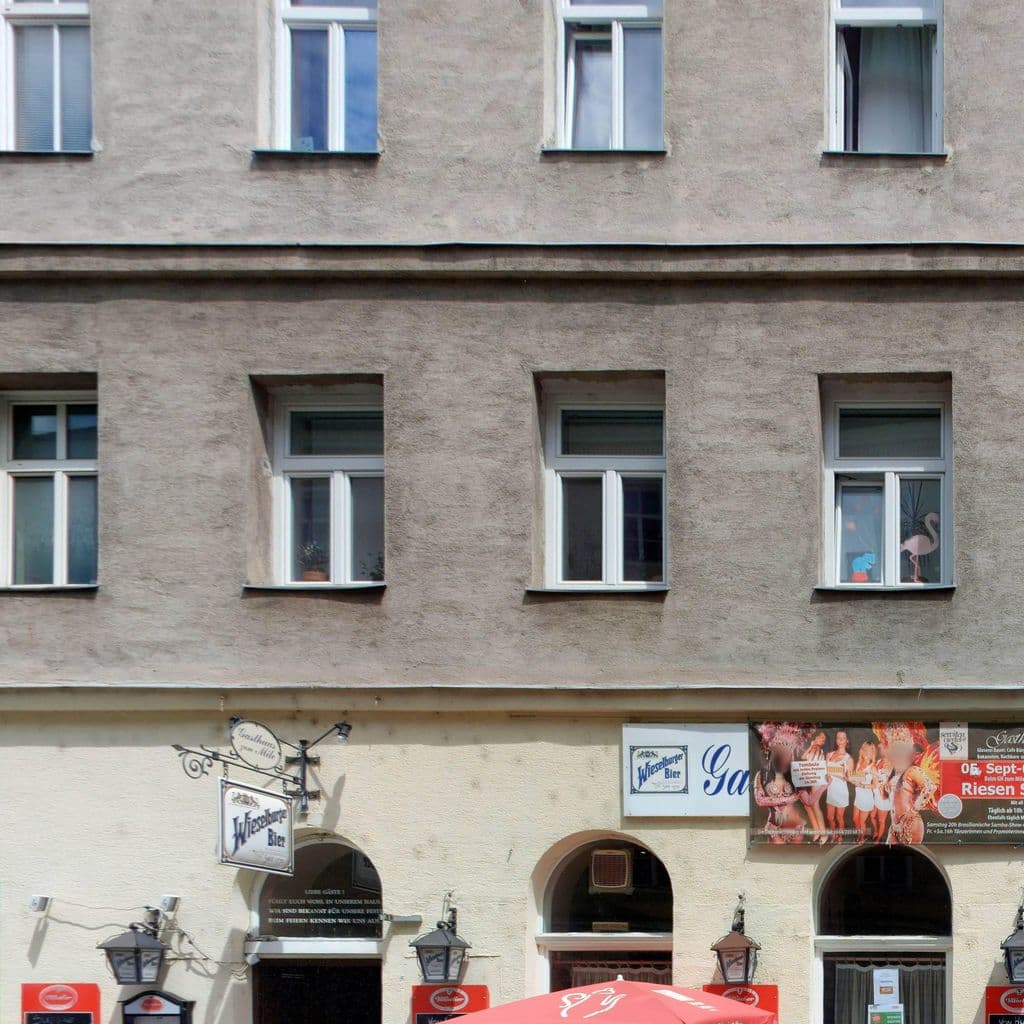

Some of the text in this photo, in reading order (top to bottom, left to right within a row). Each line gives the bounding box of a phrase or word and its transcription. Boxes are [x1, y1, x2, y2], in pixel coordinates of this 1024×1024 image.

[637, 752, 684, 790] Wieselburger
[664, 767, 681, 780] Bier
[961, 782, 1015, 796] Riesen
[231, 807, 288, 857] Wieselburger
[267, 828, 286, 848] Bier
